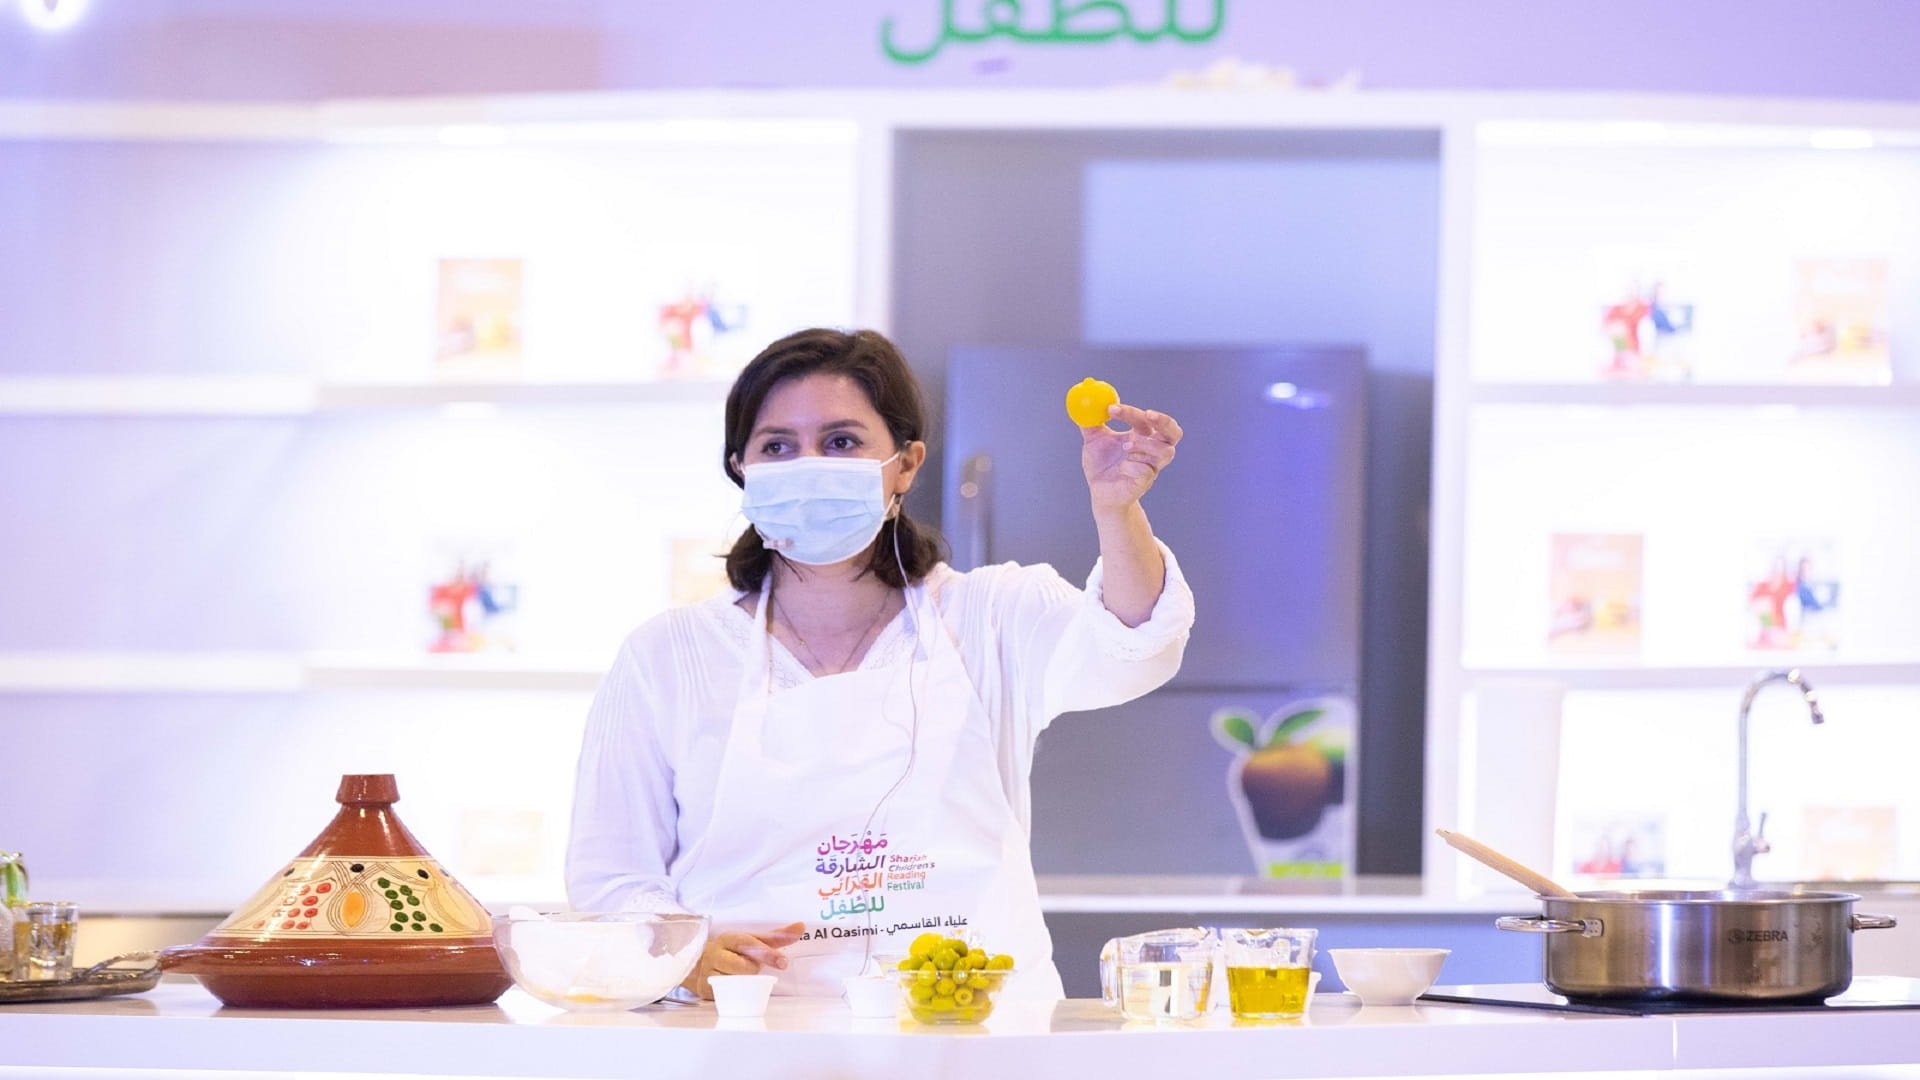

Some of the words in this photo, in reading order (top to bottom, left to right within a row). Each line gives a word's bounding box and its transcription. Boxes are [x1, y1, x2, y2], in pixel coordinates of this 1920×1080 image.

[887, 871, 926, 880] Reading
[887, 879, 924, 891] Festival
[814, 928, 828, 939] Al
[831, 925, 877, 938] Qasimi
[886, 917, 940, 936] القاسمي
[1746, 930, 1789, 942] ZEBRA
